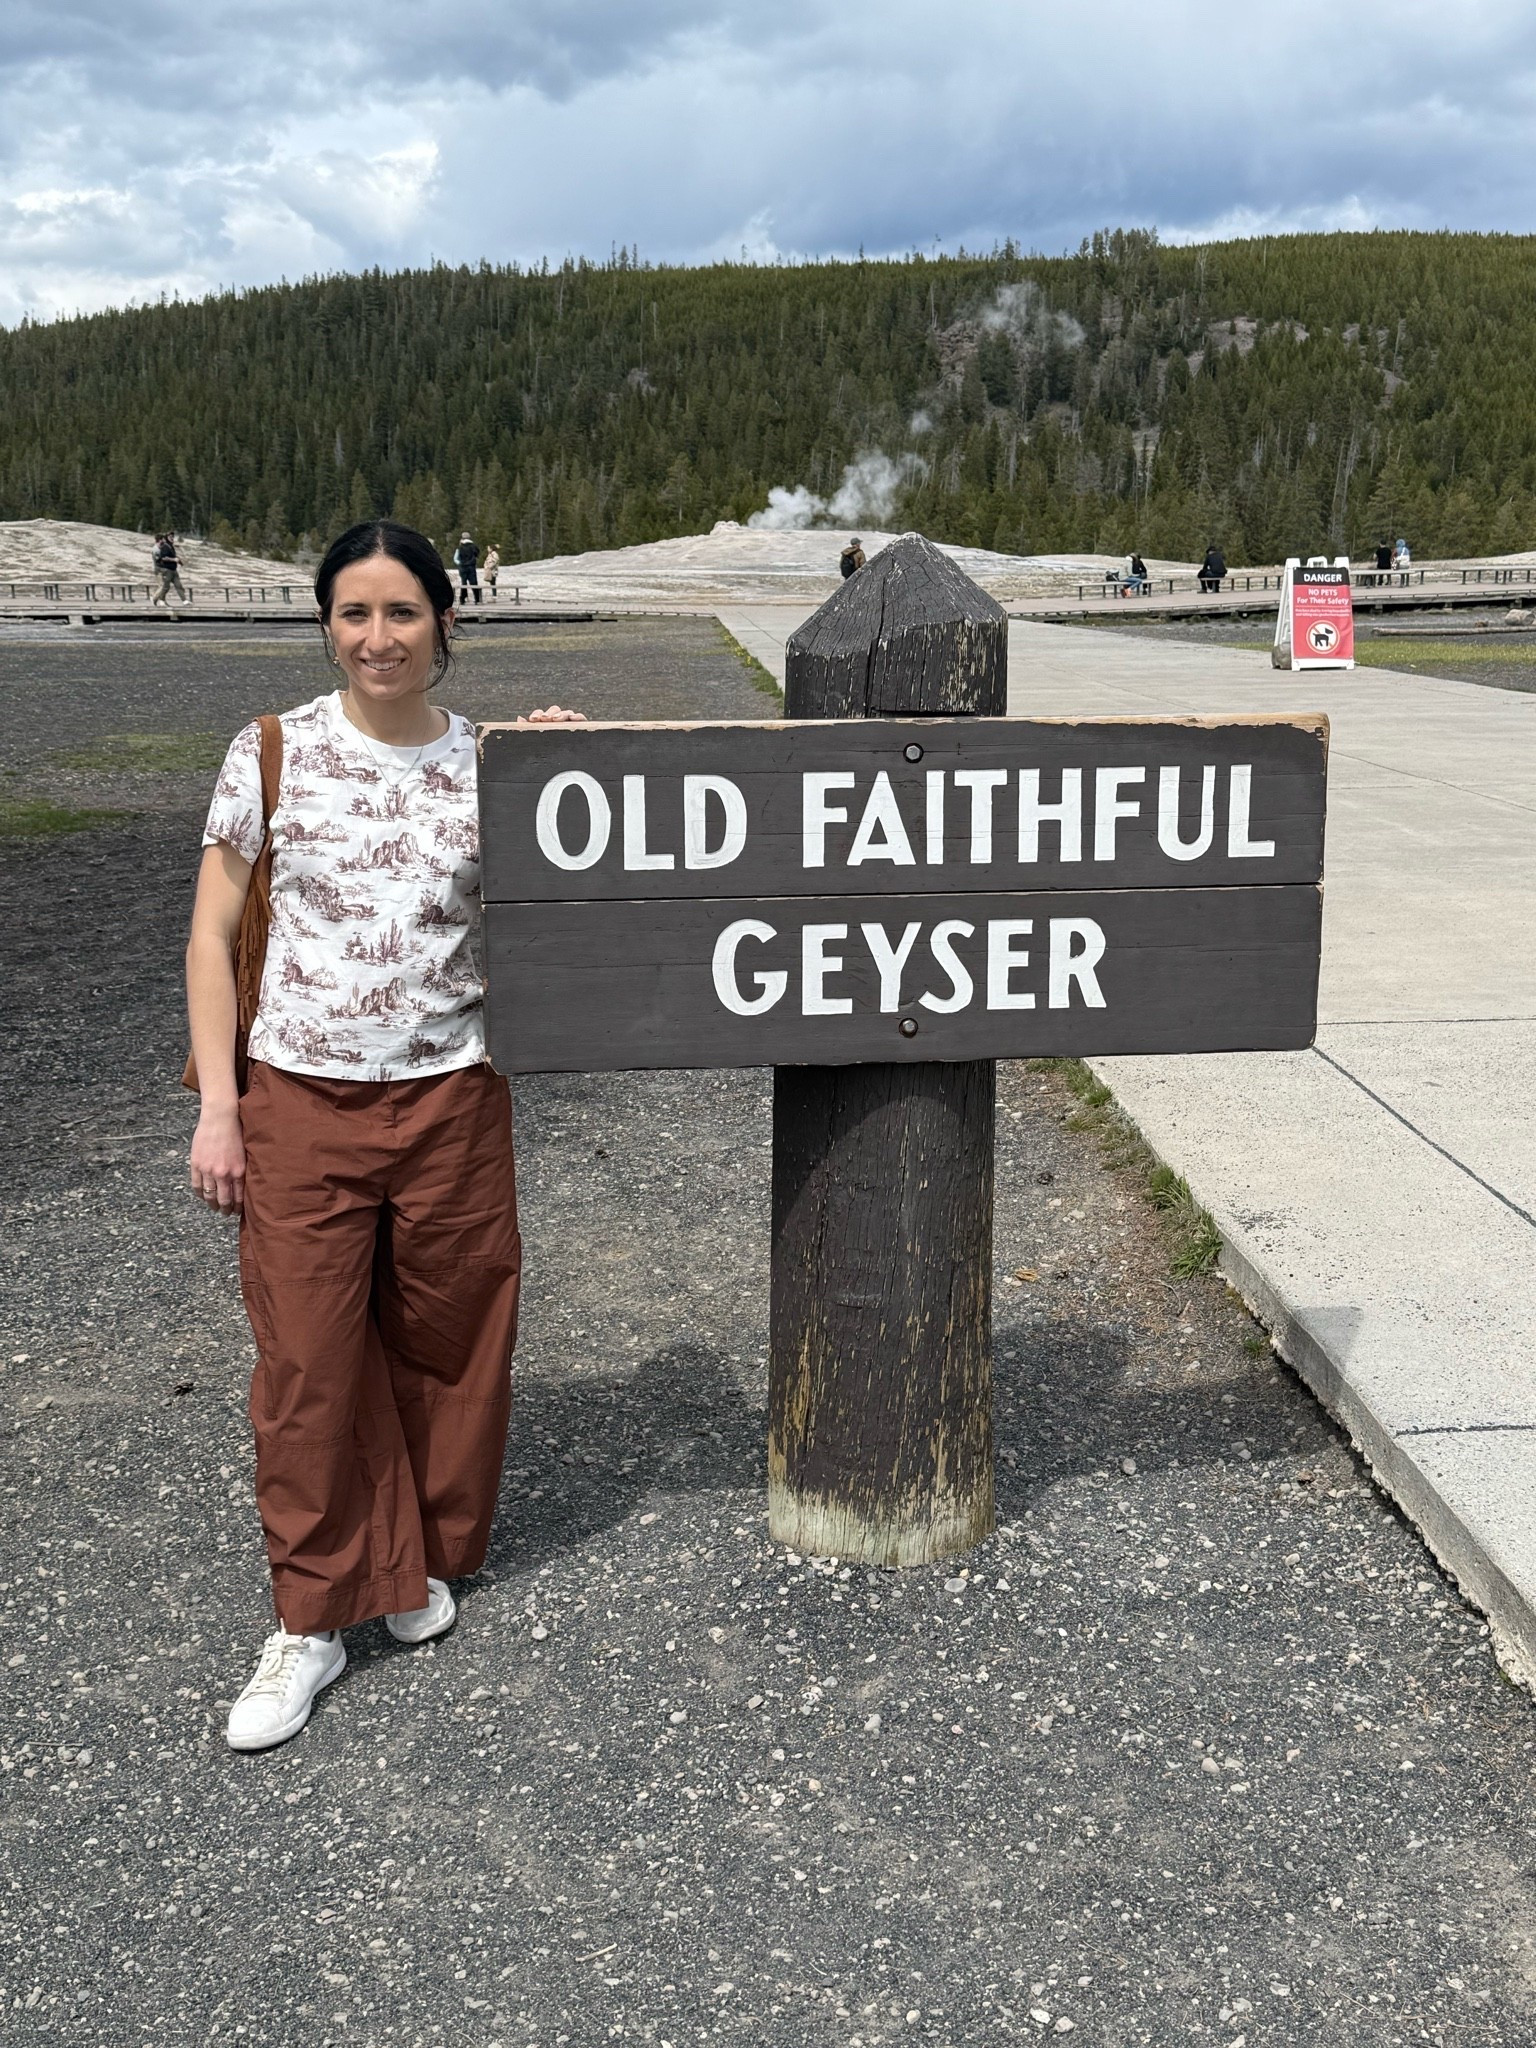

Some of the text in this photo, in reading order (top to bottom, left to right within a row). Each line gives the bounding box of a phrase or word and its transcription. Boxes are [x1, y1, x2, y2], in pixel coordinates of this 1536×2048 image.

[1303, 573, 1342, 583] DANGER
[1308, 588, 1338, 596] NO PETS
[1327, 597, 1349, 605] Safety
[536, 764, 1276, 871] OLD FAITHFUL
[711, 918, 1107, 1016] GEYSER
